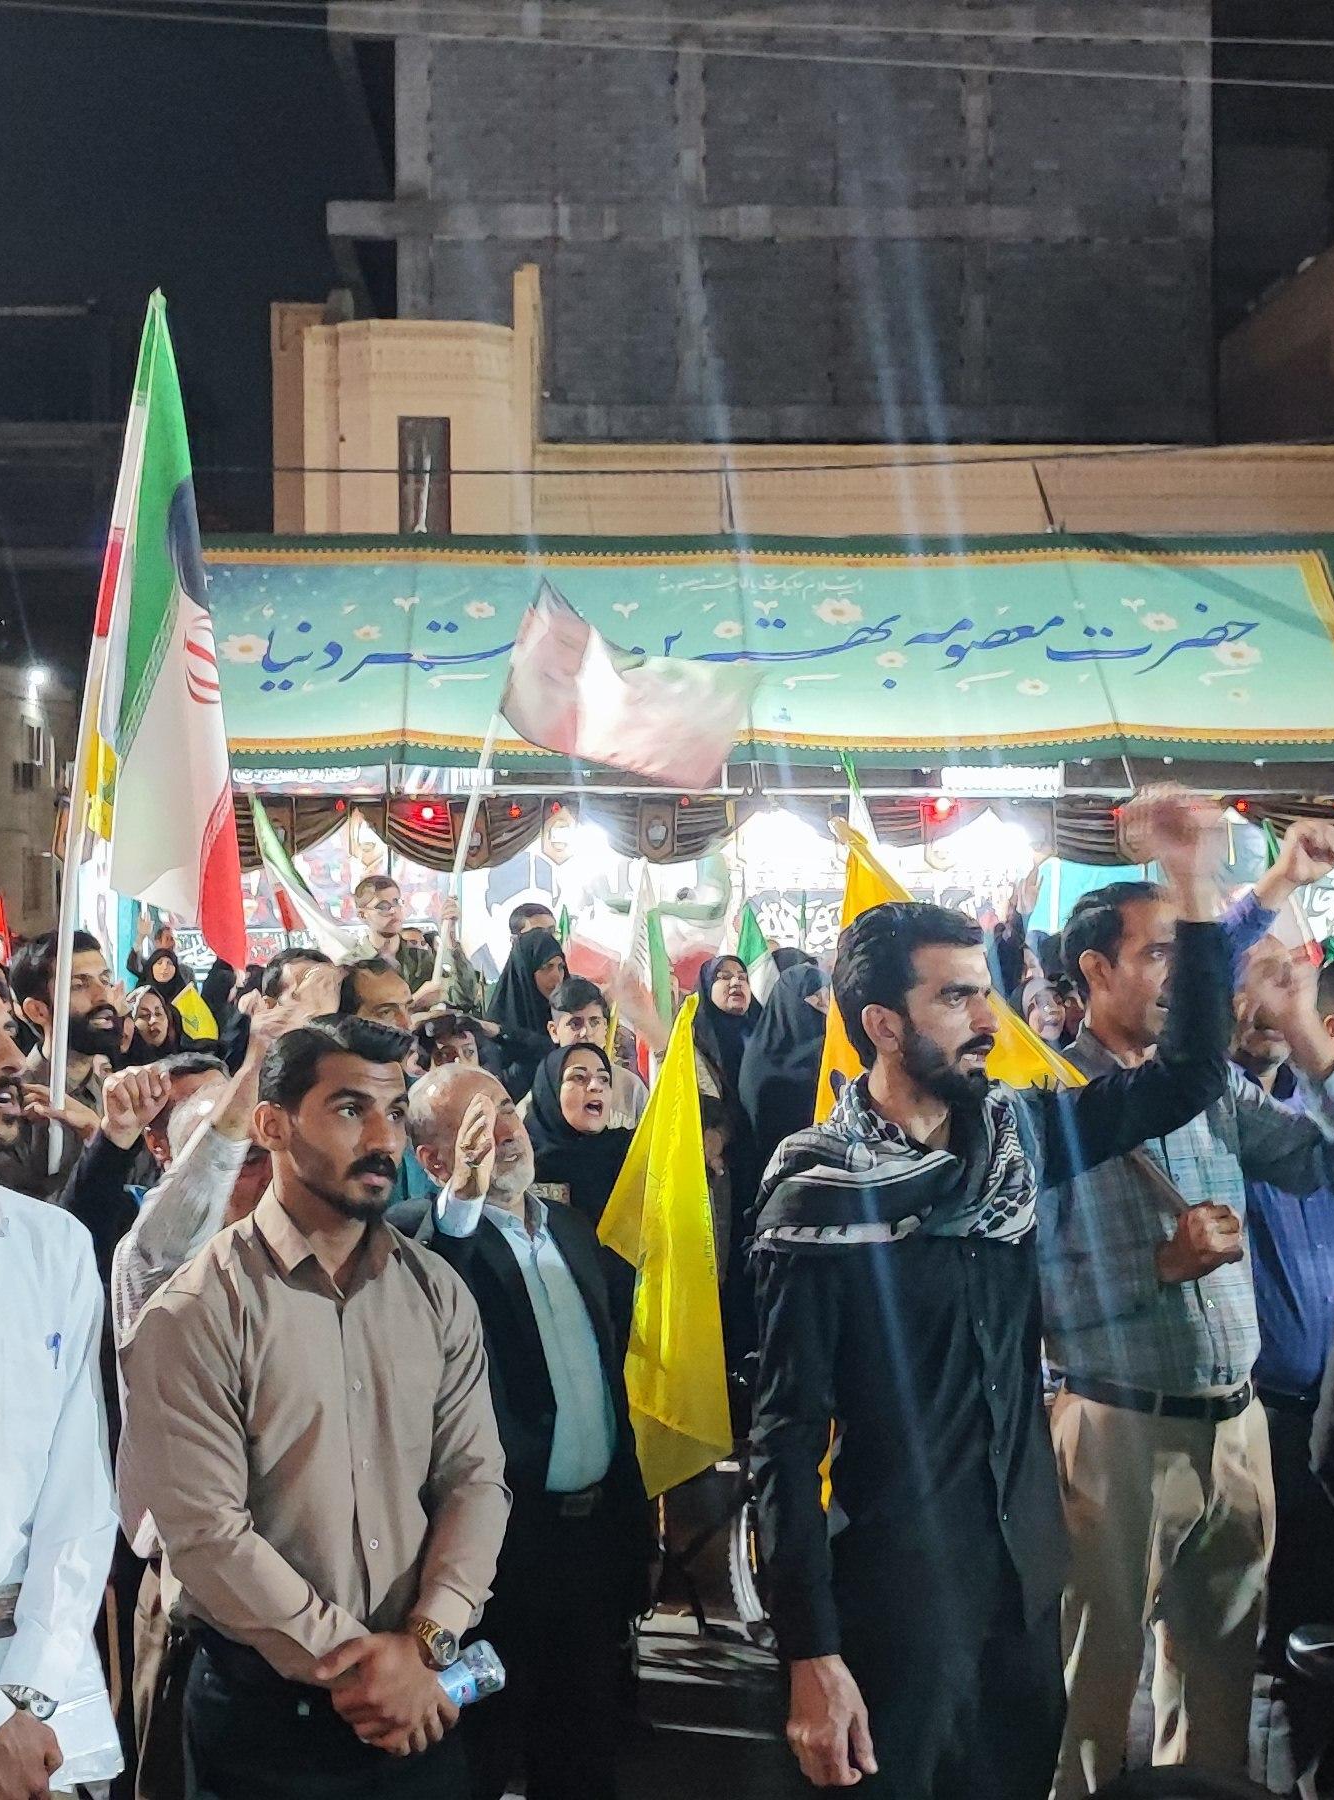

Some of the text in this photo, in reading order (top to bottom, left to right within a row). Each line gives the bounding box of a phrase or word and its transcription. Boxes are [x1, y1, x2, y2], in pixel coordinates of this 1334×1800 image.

[258, 620, 344, 692] دنیا
[630, 614, 901, 690] بهتر
[903, 615, 1066, 672] معصومه
[1046, 602, 1260, 676] حضرت
